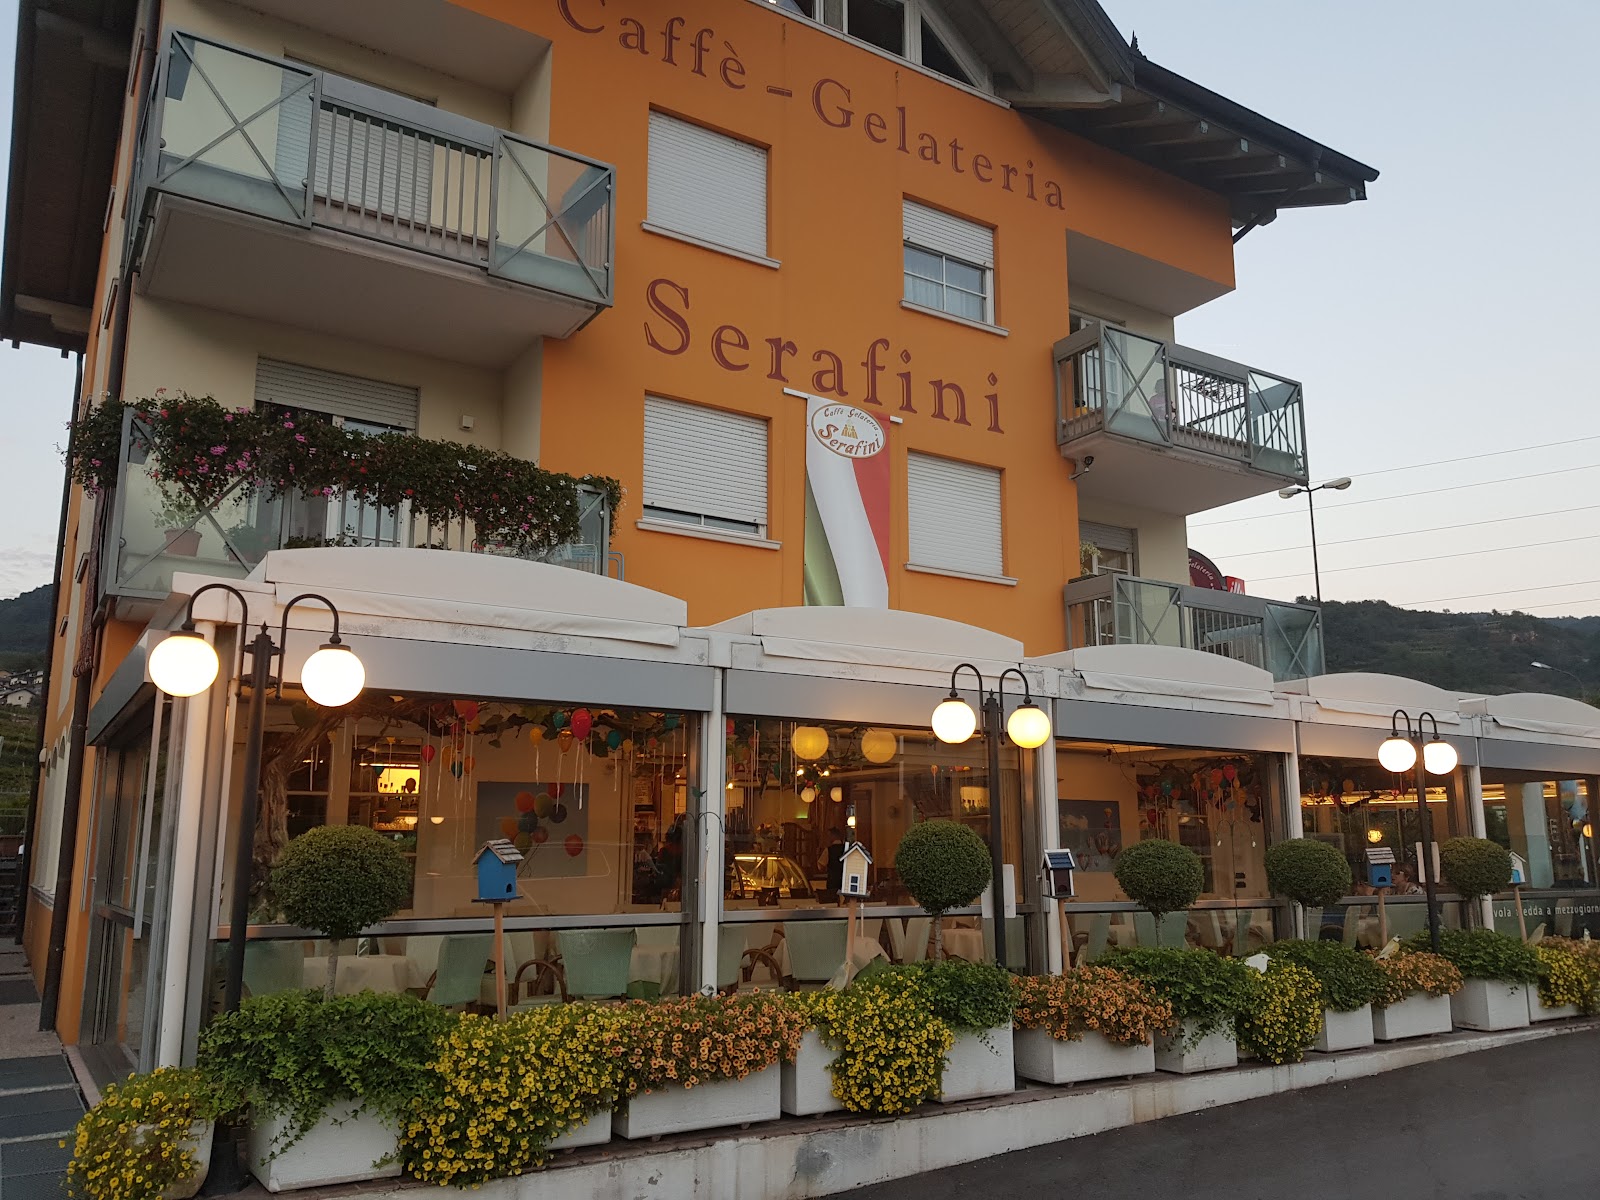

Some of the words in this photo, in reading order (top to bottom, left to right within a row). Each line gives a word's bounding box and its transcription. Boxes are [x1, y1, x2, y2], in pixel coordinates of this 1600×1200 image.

[556, 0, 746, 90] Caffè
[812, 78, 1066, 211] Gelateria
[643, 278, 1005, 435] Serafini
[817, 423, 881, 456] Serafini
[847, 408, 879, 431] Gelateria
